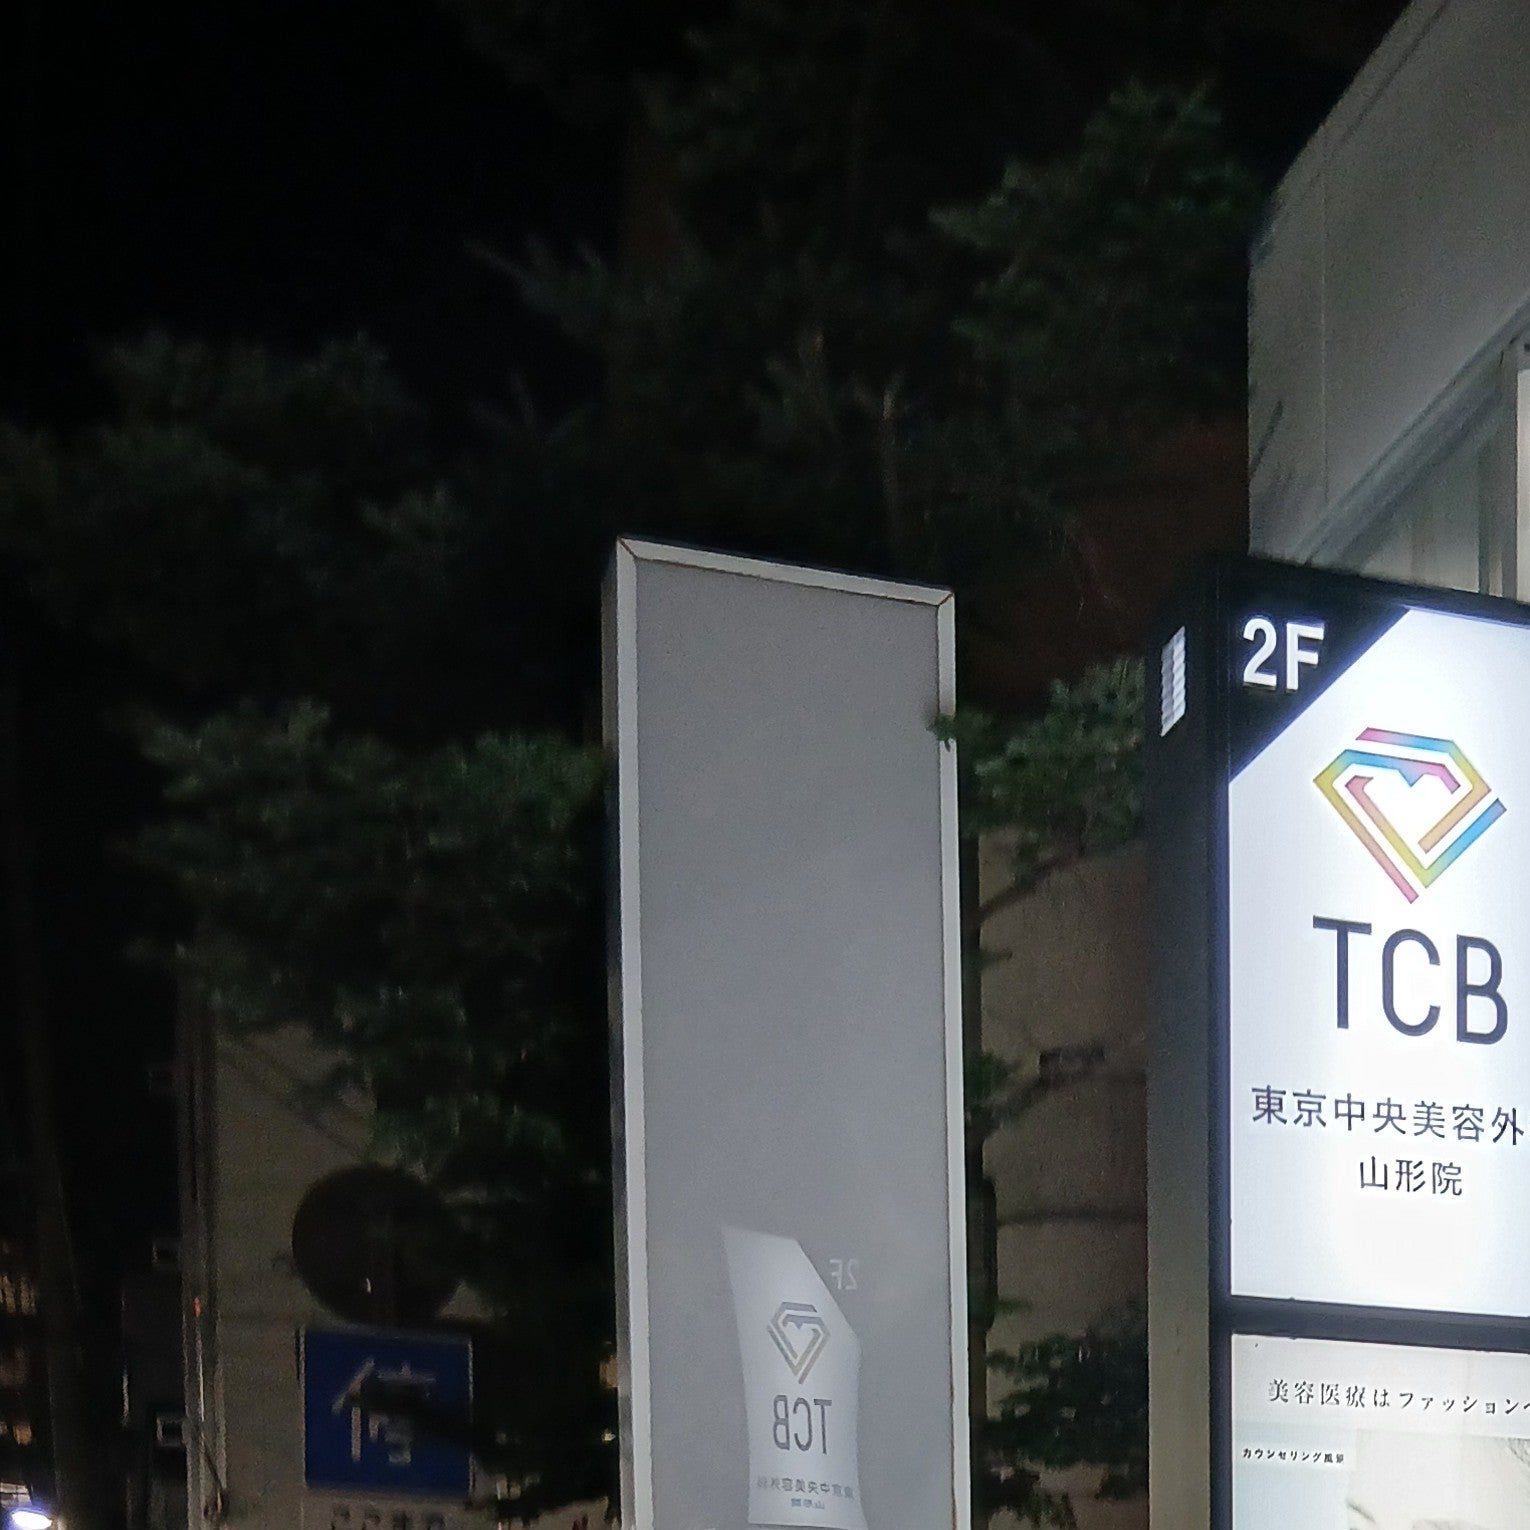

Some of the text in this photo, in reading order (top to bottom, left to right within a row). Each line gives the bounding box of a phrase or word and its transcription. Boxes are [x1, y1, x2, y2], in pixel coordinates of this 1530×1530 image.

[1241, 616, 1324, 691] 2F
[1312, 914, 1509, 1047] TCB
[1358, 1154, 1464, 1197] 山形院
